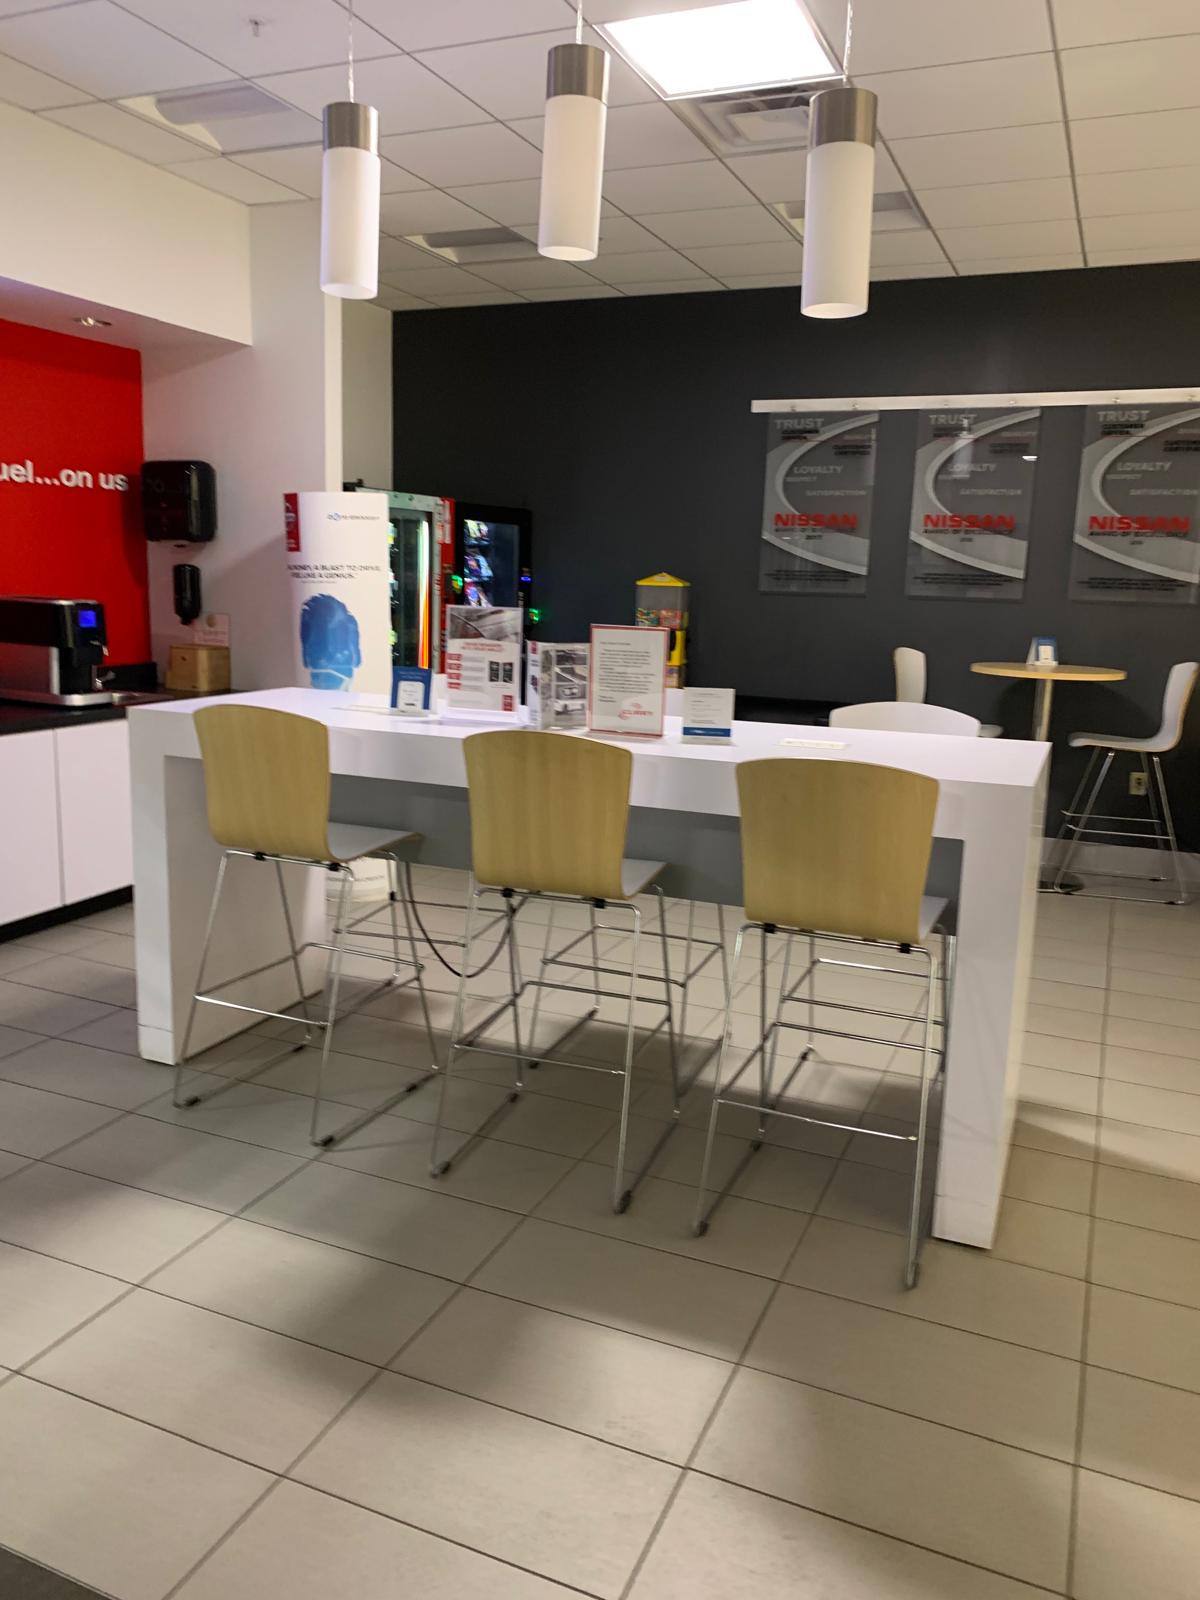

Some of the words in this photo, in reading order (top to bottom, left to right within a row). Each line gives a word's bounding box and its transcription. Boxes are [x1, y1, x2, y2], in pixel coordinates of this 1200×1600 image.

[928, 413, 978, 425] TRUST
[1098, 410, 1149, 422] TRUST
[774, 418, 825, 430] TRUST
[793, 465, 844, 475] LOYALTY
[1116, 461, 1172, 472] LOYALTY
[98, 472, 129, 492] us
[773, 512, 858, 529] NISSAN
[923, 513, 1016, 529] NISSAN
[1088, 515, 1191, 531] NISSAN
